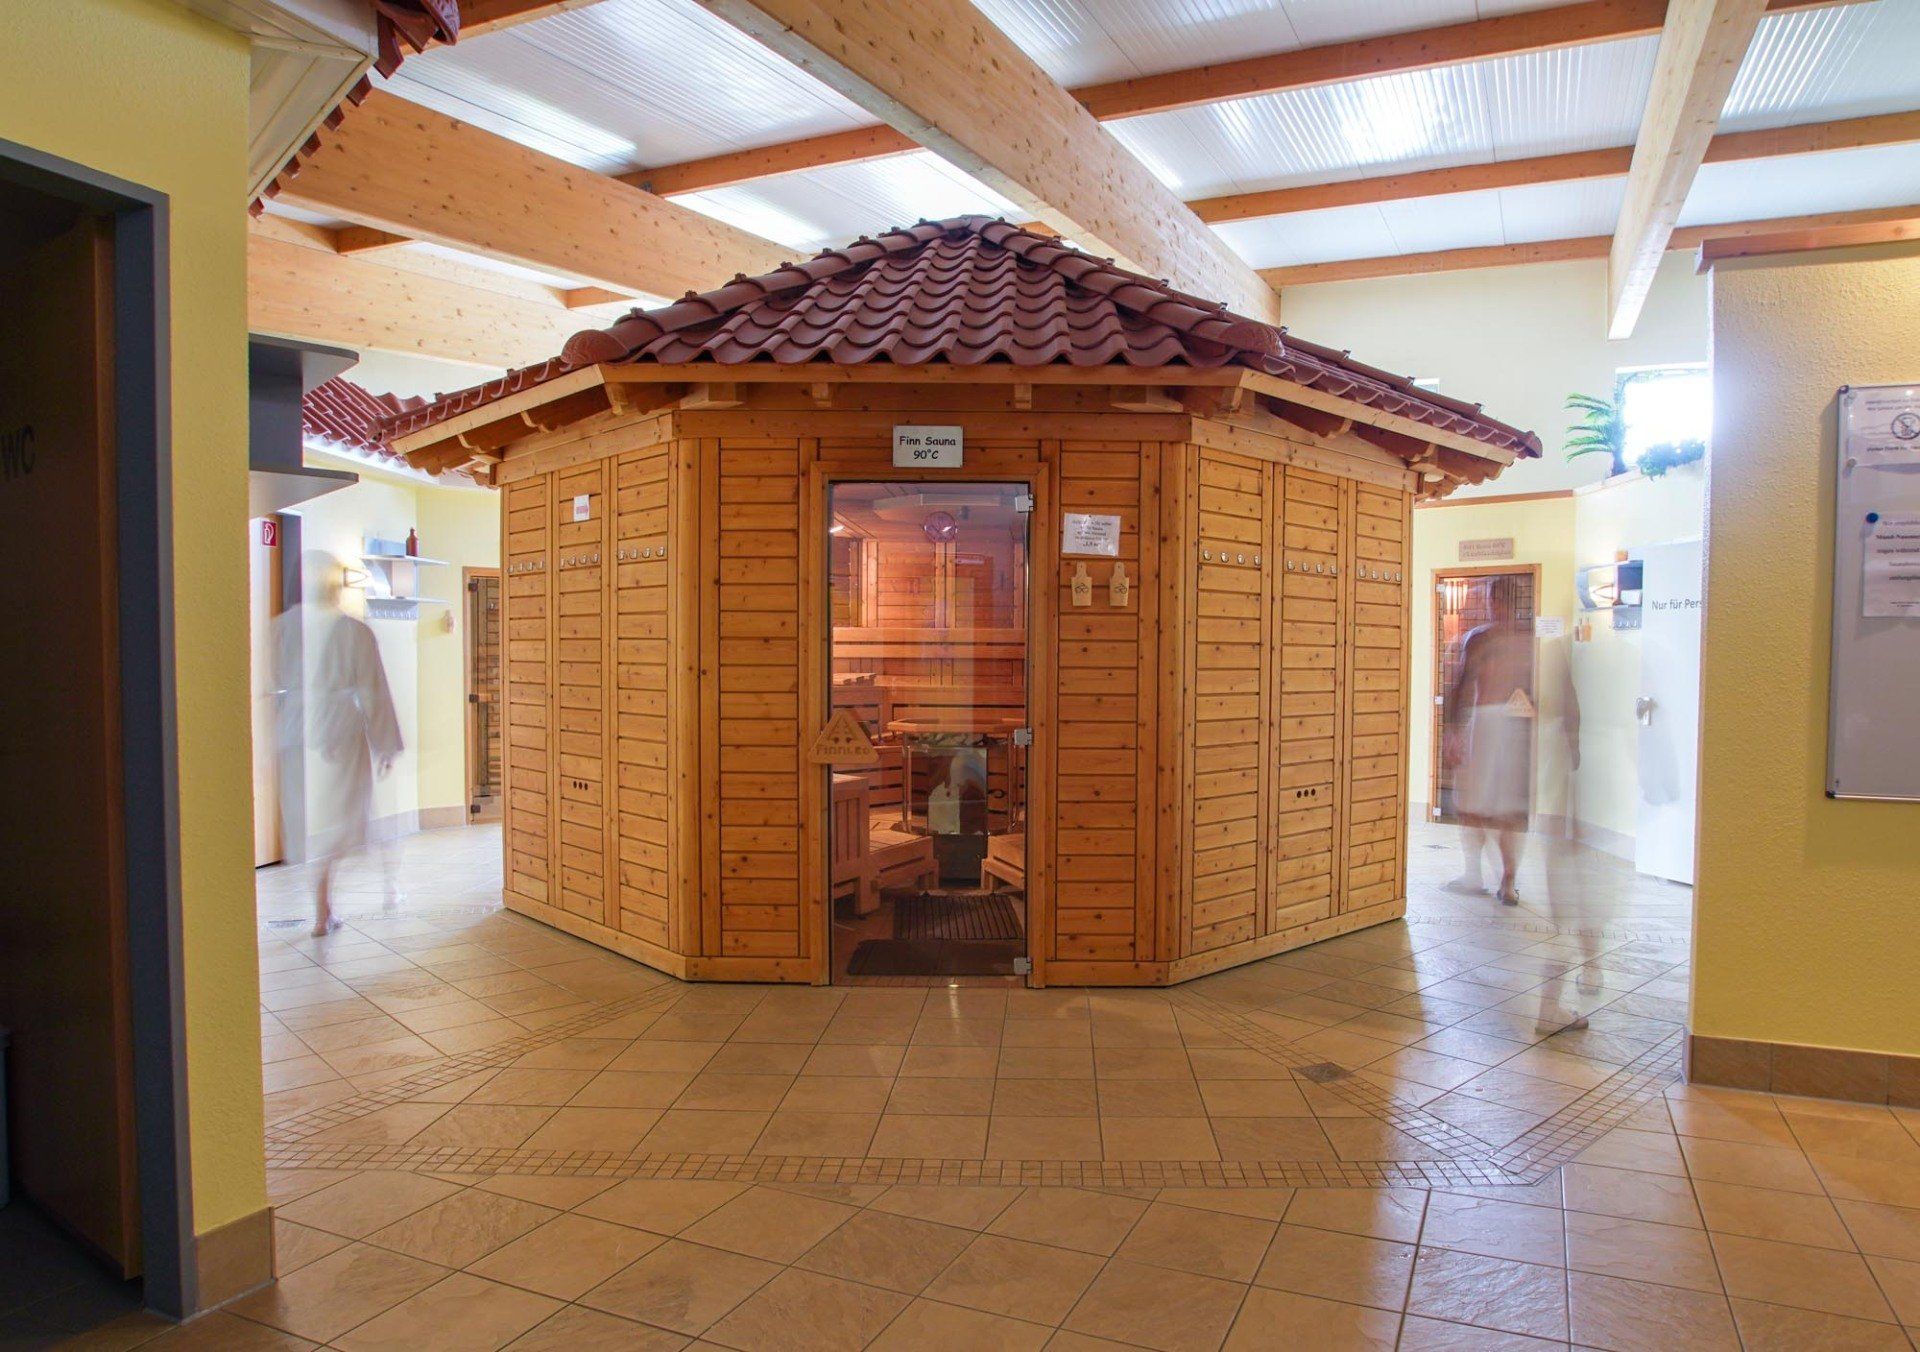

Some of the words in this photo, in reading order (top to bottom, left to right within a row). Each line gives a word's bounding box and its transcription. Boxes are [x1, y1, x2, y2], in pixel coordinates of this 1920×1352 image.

[899, 435, 921, 446] Finn
[924, 436, 956, 446] Sauna
[1, 426, 36, 482] WC
[913, 448, 939, 460] 90°C
[1651, 600, 1667, 611] Nur
[1669, 598, 1682, 610] für
